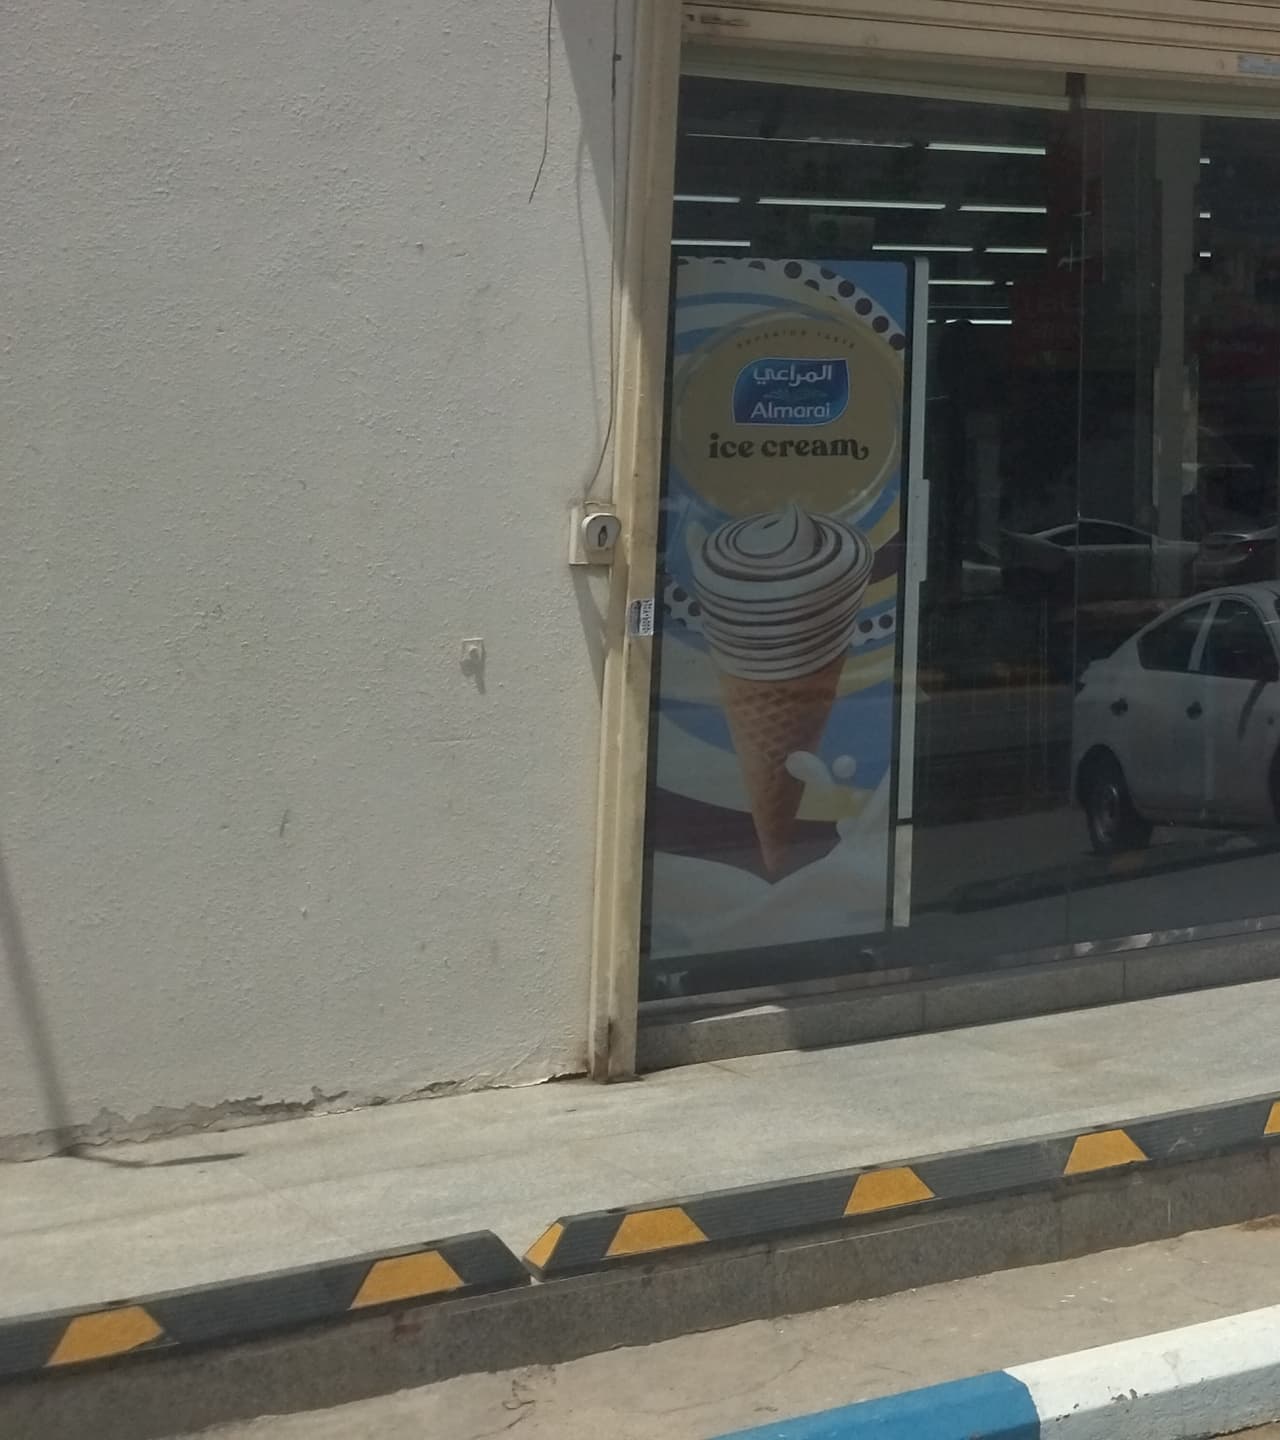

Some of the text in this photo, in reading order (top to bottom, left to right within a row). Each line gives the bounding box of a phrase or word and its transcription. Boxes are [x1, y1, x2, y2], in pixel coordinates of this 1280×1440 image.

[752, 363, 833, 387] المراعي
[750, 401, 831, 419] Almarai
[708, 432, 869, 461] ice cream
